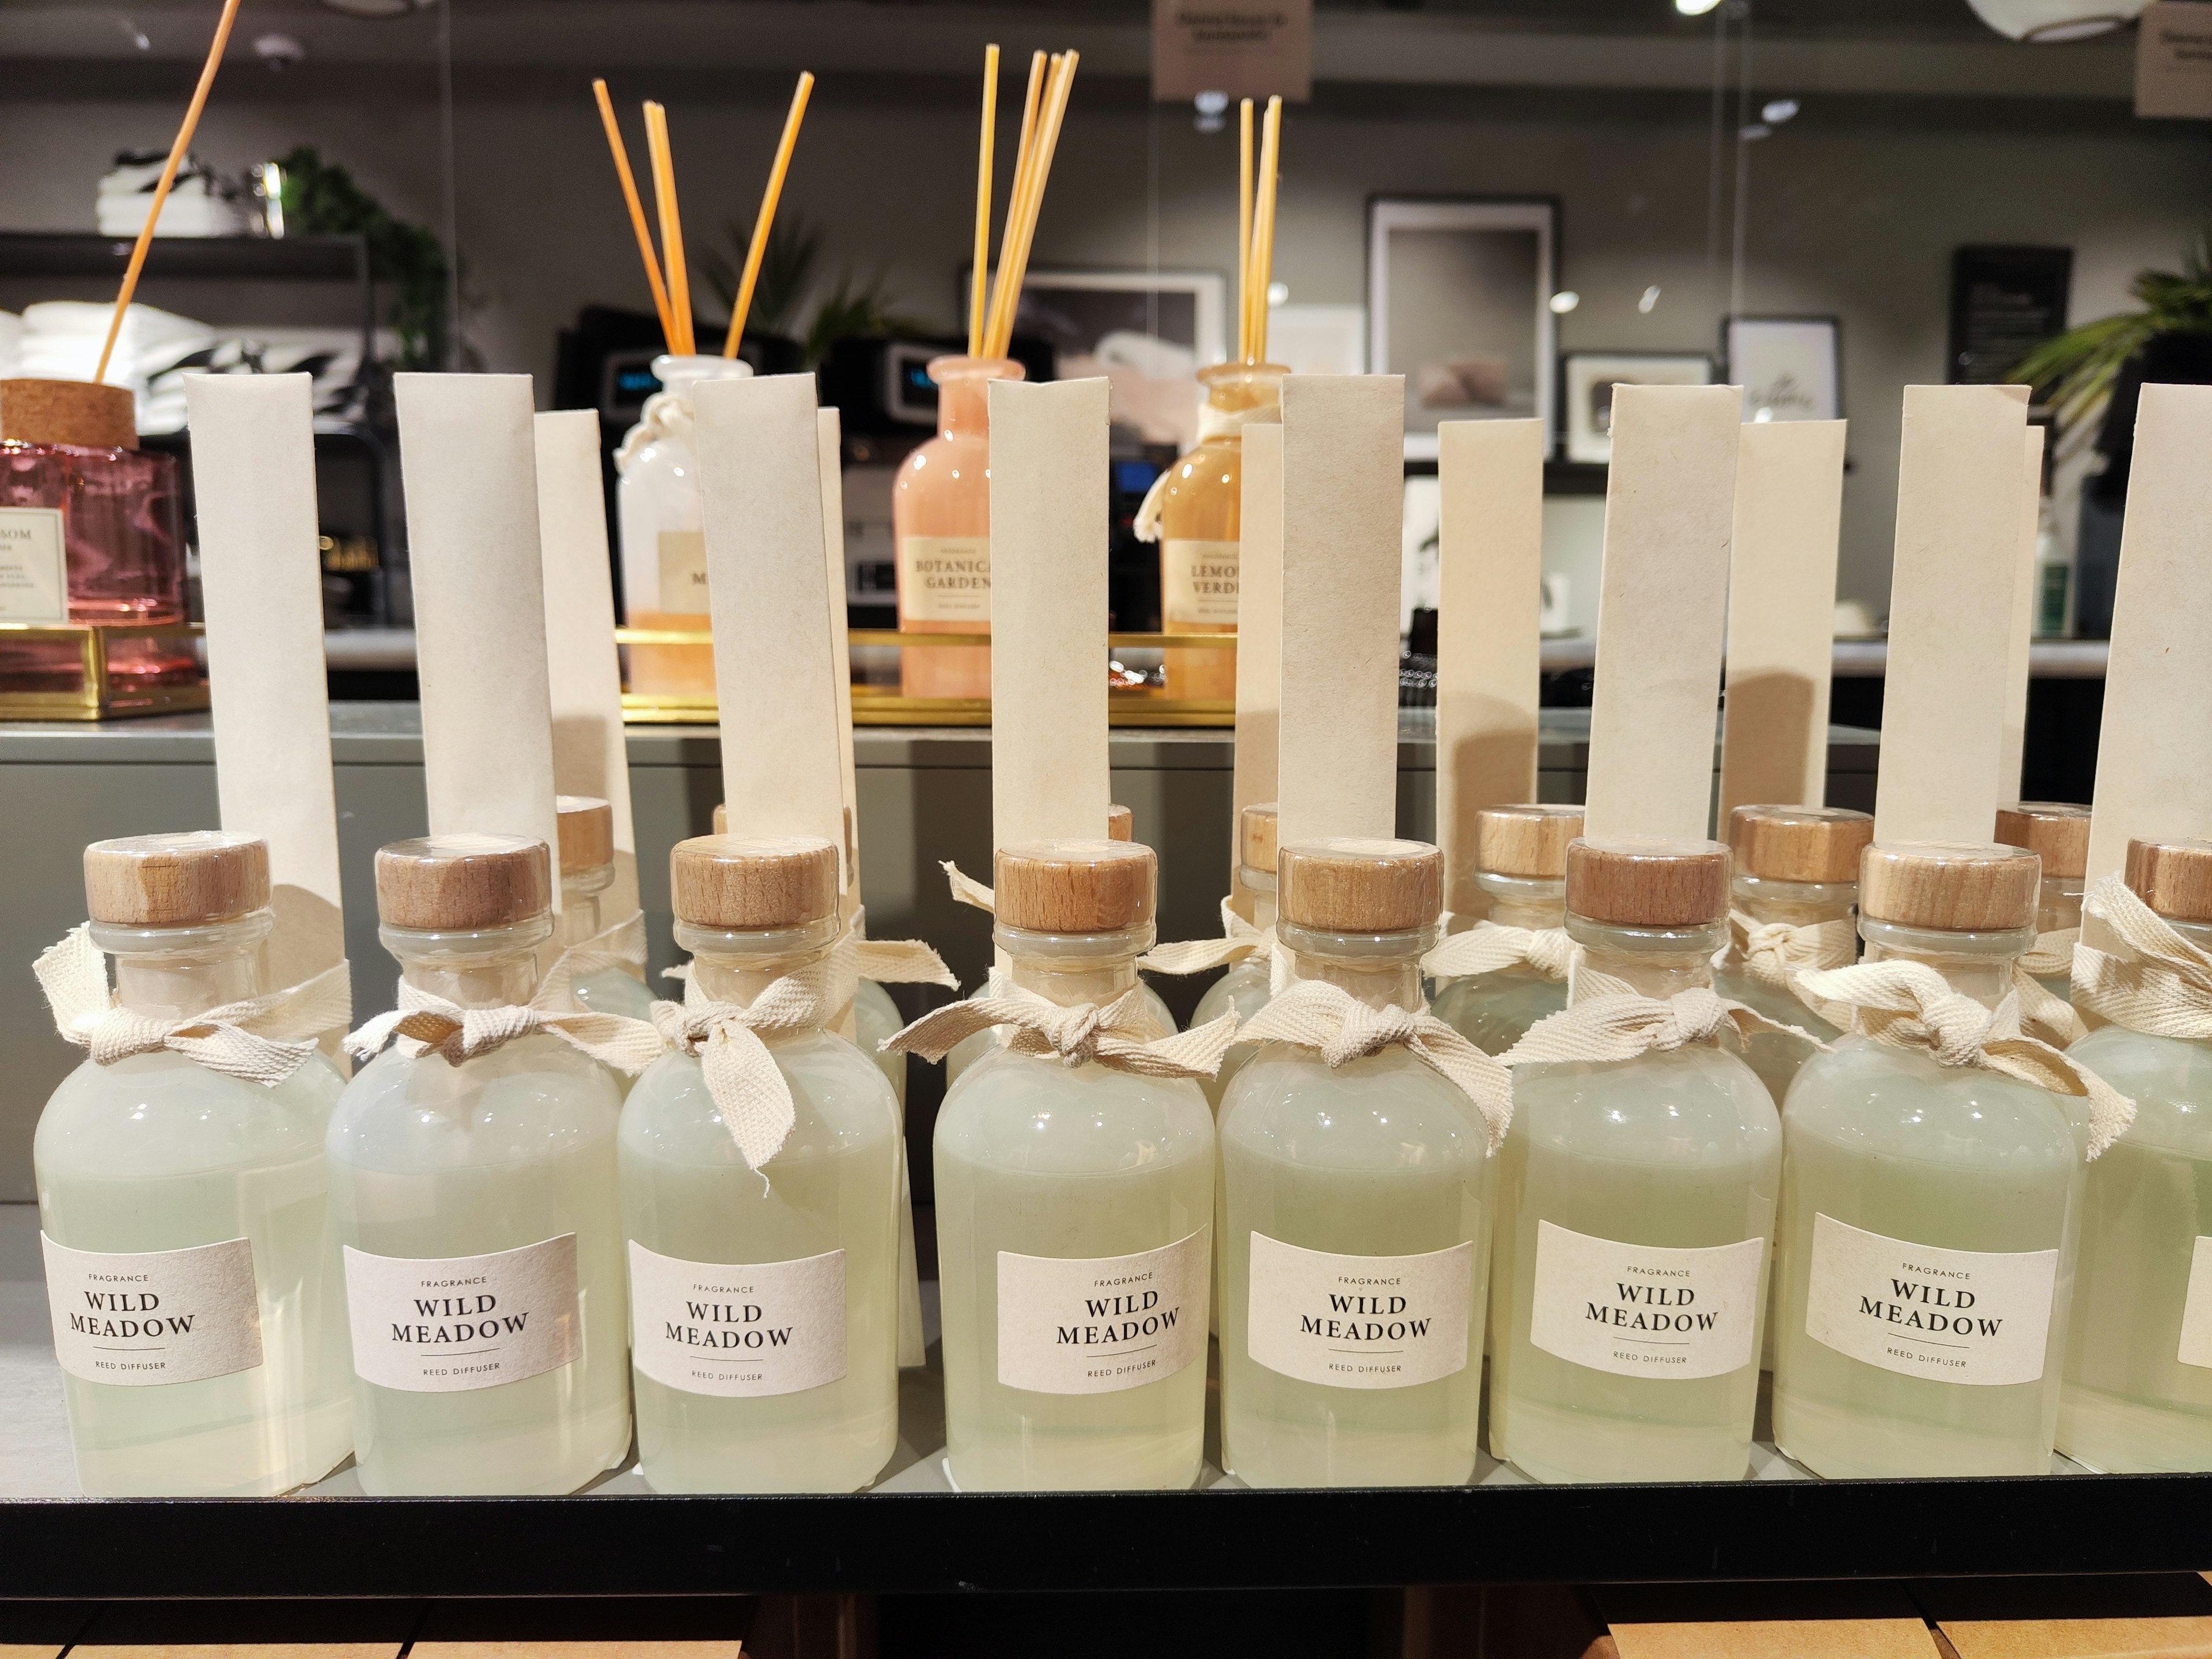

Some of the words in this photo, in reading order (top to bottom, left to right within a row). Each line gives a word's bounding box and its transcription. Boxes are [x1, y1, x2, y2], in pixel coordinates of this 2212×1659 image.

[1191, 565, 1239, 577] LEMO
[89, 1274, 148, 1282] FRAGRANCE
[1094, 1272, 1152, 1287] FRAGRANCE
[1339, 1277, 1400, 1285] FRAGRANCE
[1627, 1266, 1690, 1277] FRAGRANCE
[1903, 1263, 1970, 1279] FRAGRANCE
[421, 1277, 487, 1287] FRAGRANCE
[694, 1284, 753, 1293] FRAGRANCE
[84, 1291, 159, 1311] WILD
[1616, 1283, 1694, 1305] WILD
[1891, 1278, 1975, 1308] WILD
[414, 1295, 496, 1317] WILD
[686, 1301, 762, 1323] WILD
[1085, 1291, 1158, 1317] WILD
[1328, 1294, 1406, 1315] WILD
[70, 1313, 195, 1337] MEADOW
[1056, 1306, 1179, 1344] MEADOW
[1585, 1302, 1718, 1332] MEADOW
[1859, 1296, 2003, 1336] MEADOW
[392, 1312, 529, 1343] MEADOW
[666, 1321, 793, 1348] MEADOW
[1300, 1315, 1431, 1340] MEADOW
[96, 1361, 116, 1369] REED
[1117, 1359, 1156, 1374] DIFFUSER
[1613, 1351, 1638, 1360] REED
[1643, 1355, 1686, 1363] DIFFUSER
[1887, 1347, 1912, 1358] REED
[1919, 1355, 1966, 1368] DIFFUSER
[453, 1363, 499, 1374] DIFFUSER
[692, 1370, 714, 1379] REED
[1329, 1363, 1353, 1372] REED
